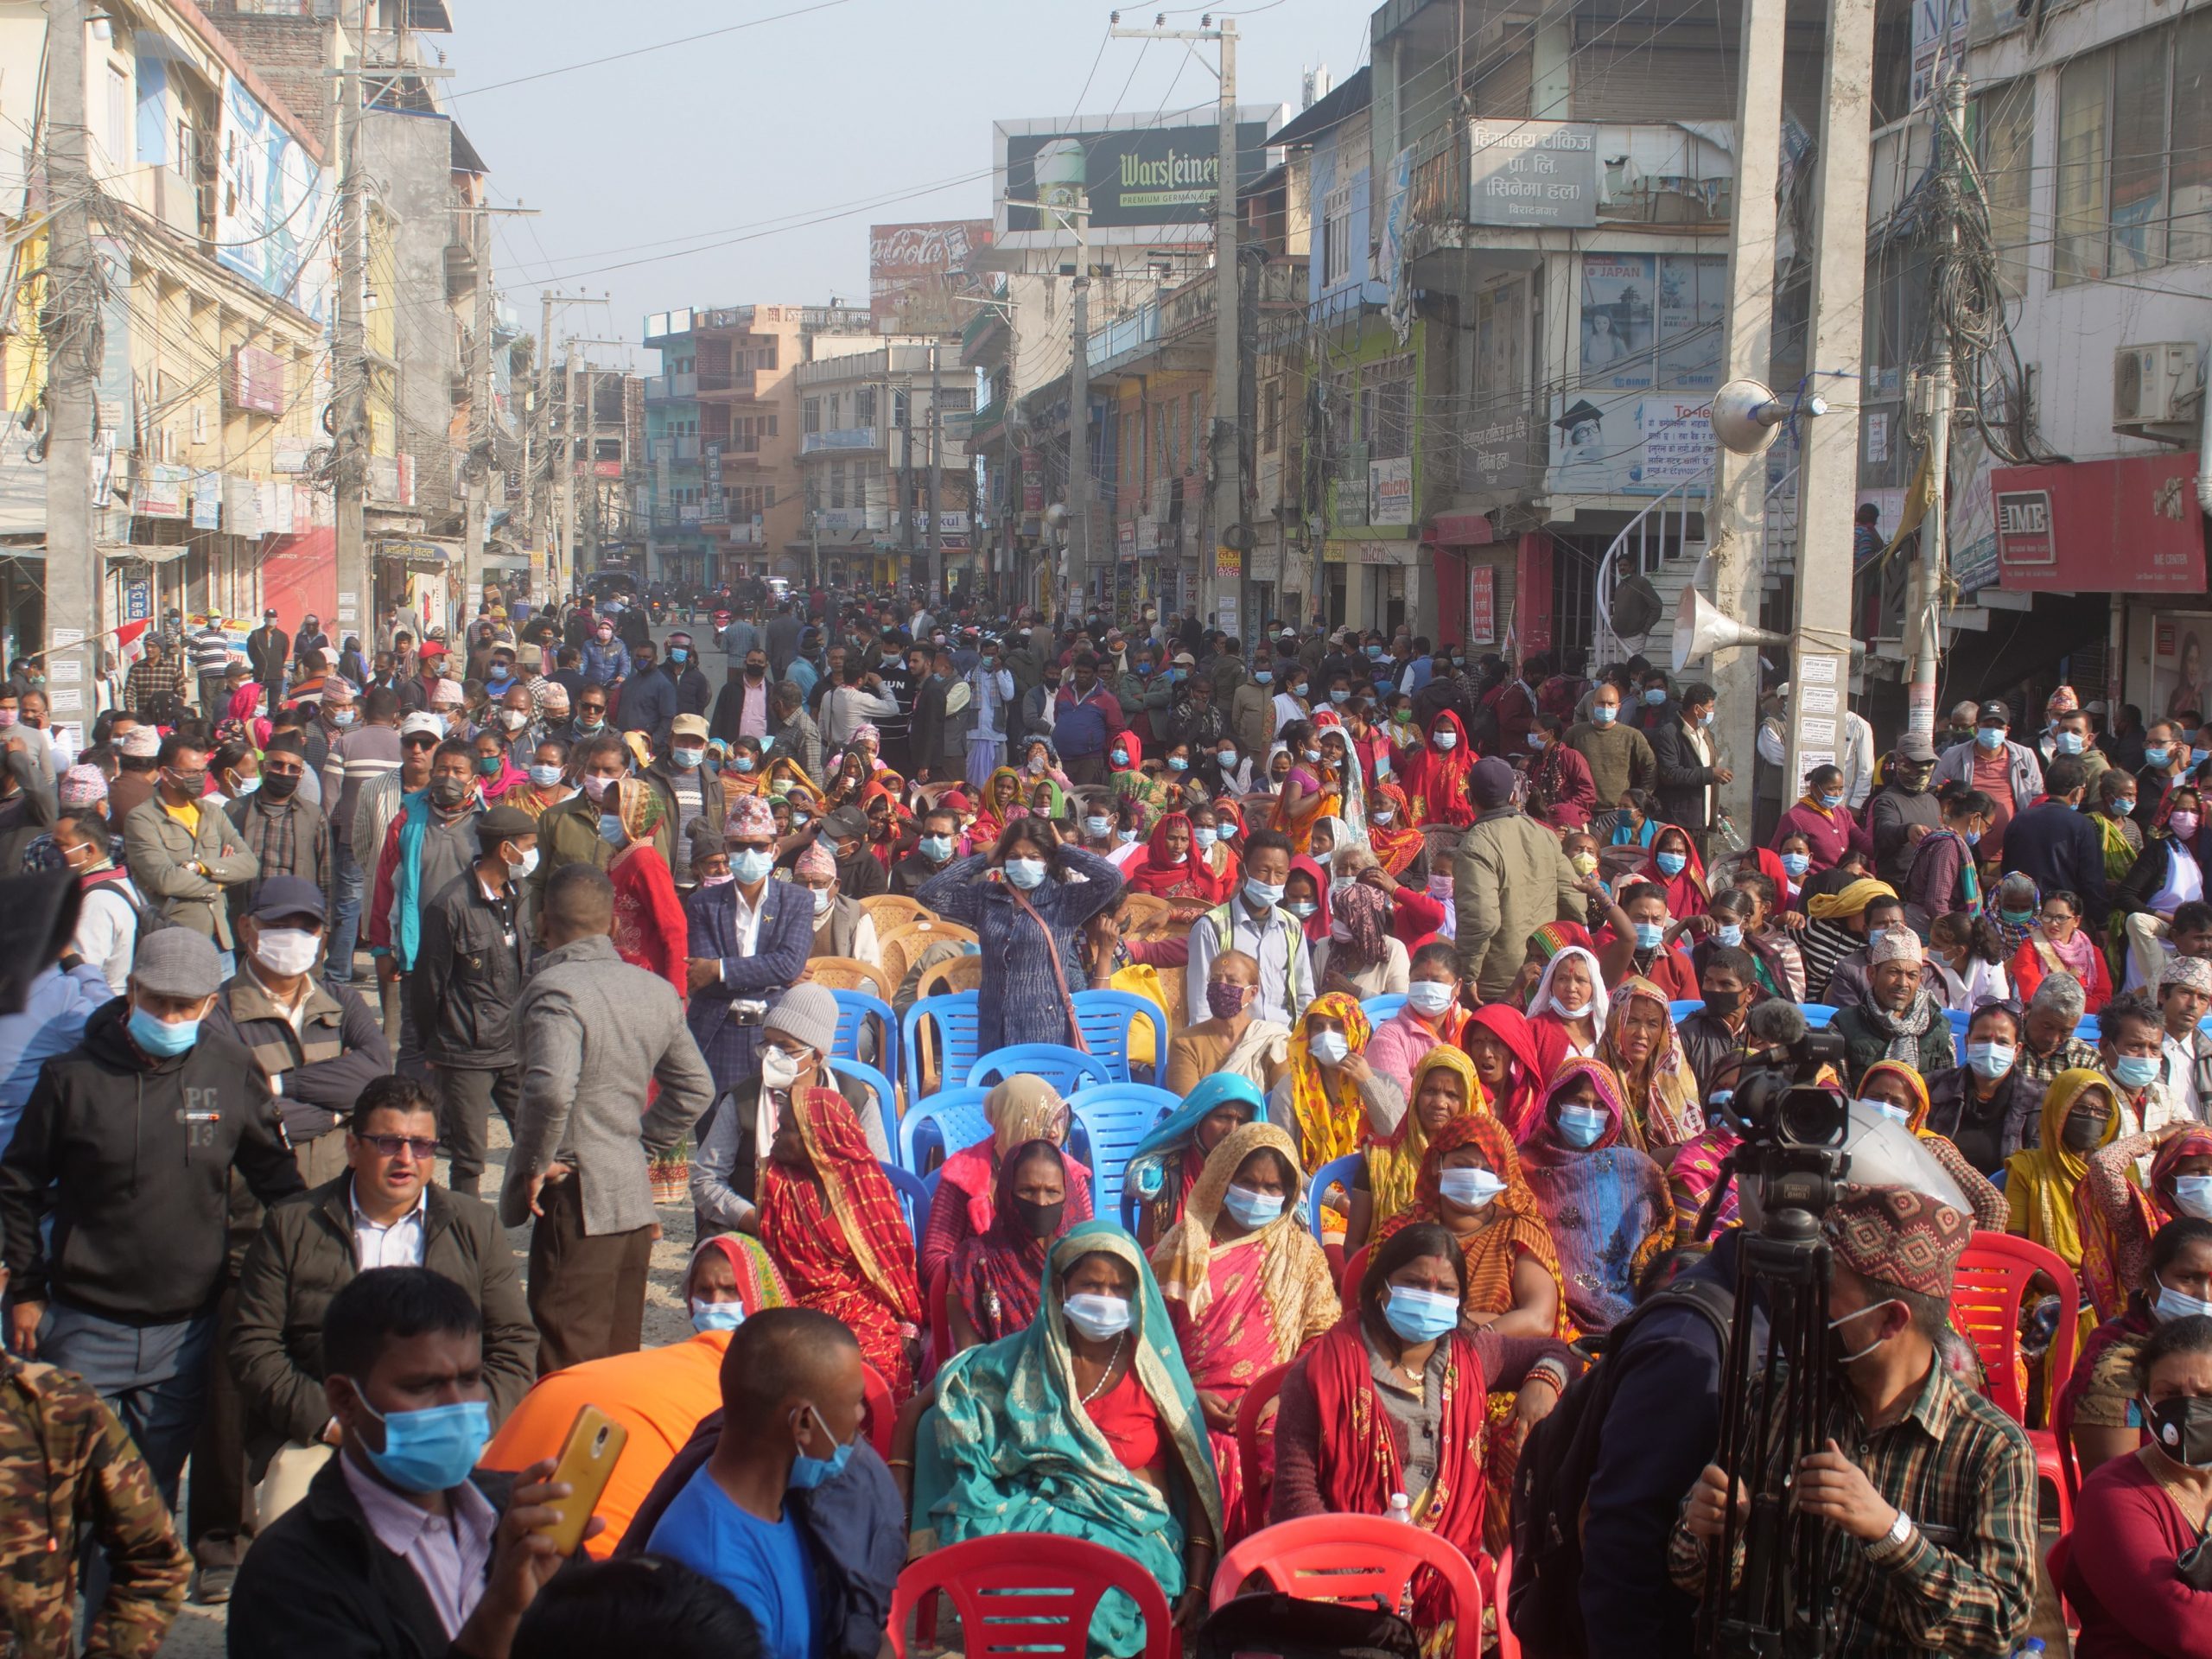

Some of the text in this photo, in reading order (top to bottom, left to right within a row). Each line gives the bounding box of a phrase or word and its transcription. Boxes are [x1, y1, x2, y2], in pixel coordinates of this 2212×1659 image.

[1541, 129, 1592, 150] टाकिज
[1120, 148, 1219, 189] Warsteiner
[1508, 154, 1559, 175] प्रा. लि.
[1122, 195, 1160, 204] PREMIUM
[1162, 194, 1197, 202] GERMAN
[1600, 267, 1641, 277] JAPAN
[1674, 405, 1713, 418] To-le
[1381, 478, 1409, 497] micro
[2005, 503, 2050, 534] IME
[1360, 545, 1386, 563] micro
